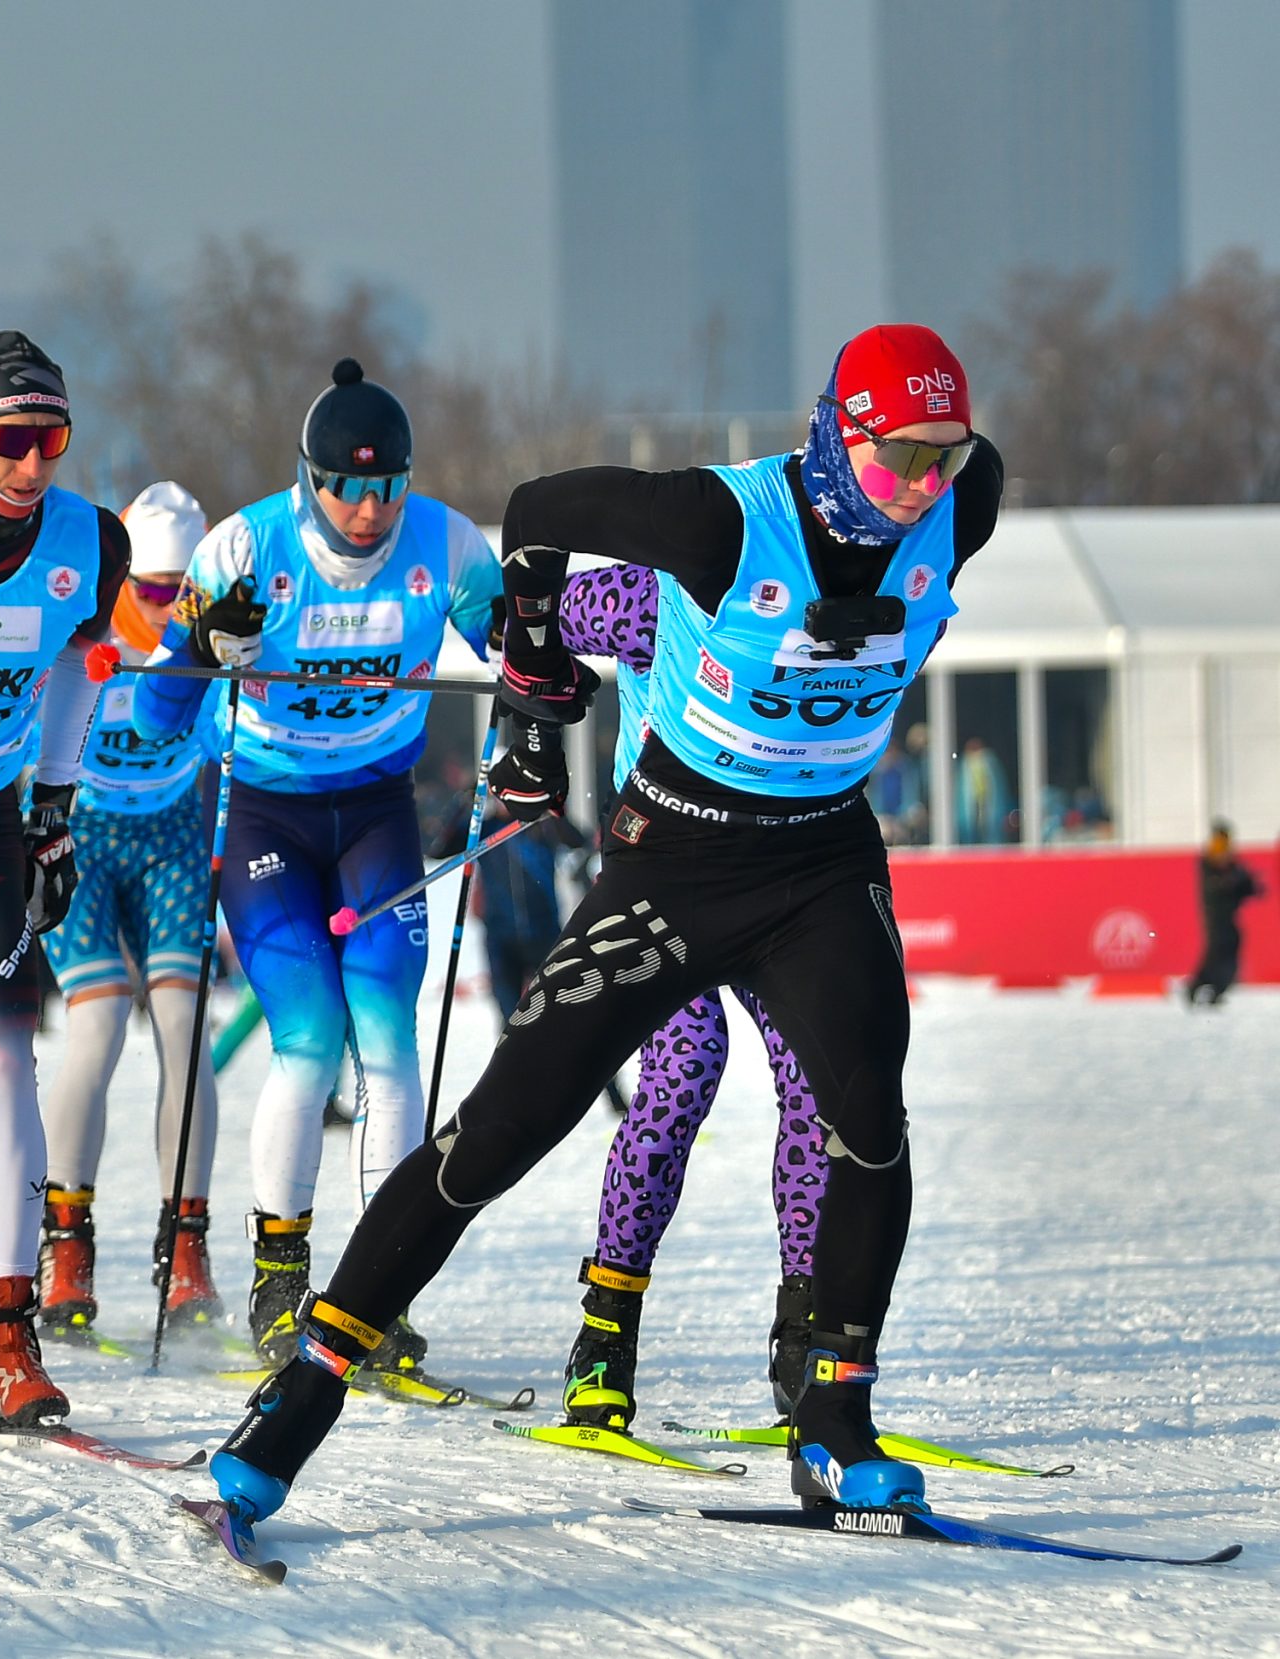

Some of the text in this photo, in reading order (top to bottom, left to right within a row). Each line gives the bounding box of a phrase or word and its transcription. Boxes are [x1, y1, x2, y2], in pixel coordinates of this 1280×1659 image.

[906, 367, 956, 395] DNB
[848, 394, 869, 414] DNB
[330, 614, 369, 628] СБЕР
[801, 677, 866, 691] FAMILY
[688, 706, 738, 741] greenworks
[763, 745, 807, 756] MAER
[832, 741, 870, 755] SYNERGETIC
[736, 761, 773, 775] СПОРТ
[630, 770, 729, 823] OSSIGNOL
[249, 861, 286, 880] SPORT
[597, 1272, 633, 1288] LIMETIME
[305, 1343, 338, 1368] SALOMON
[833, 1511, 904, 1535] SALOMON
